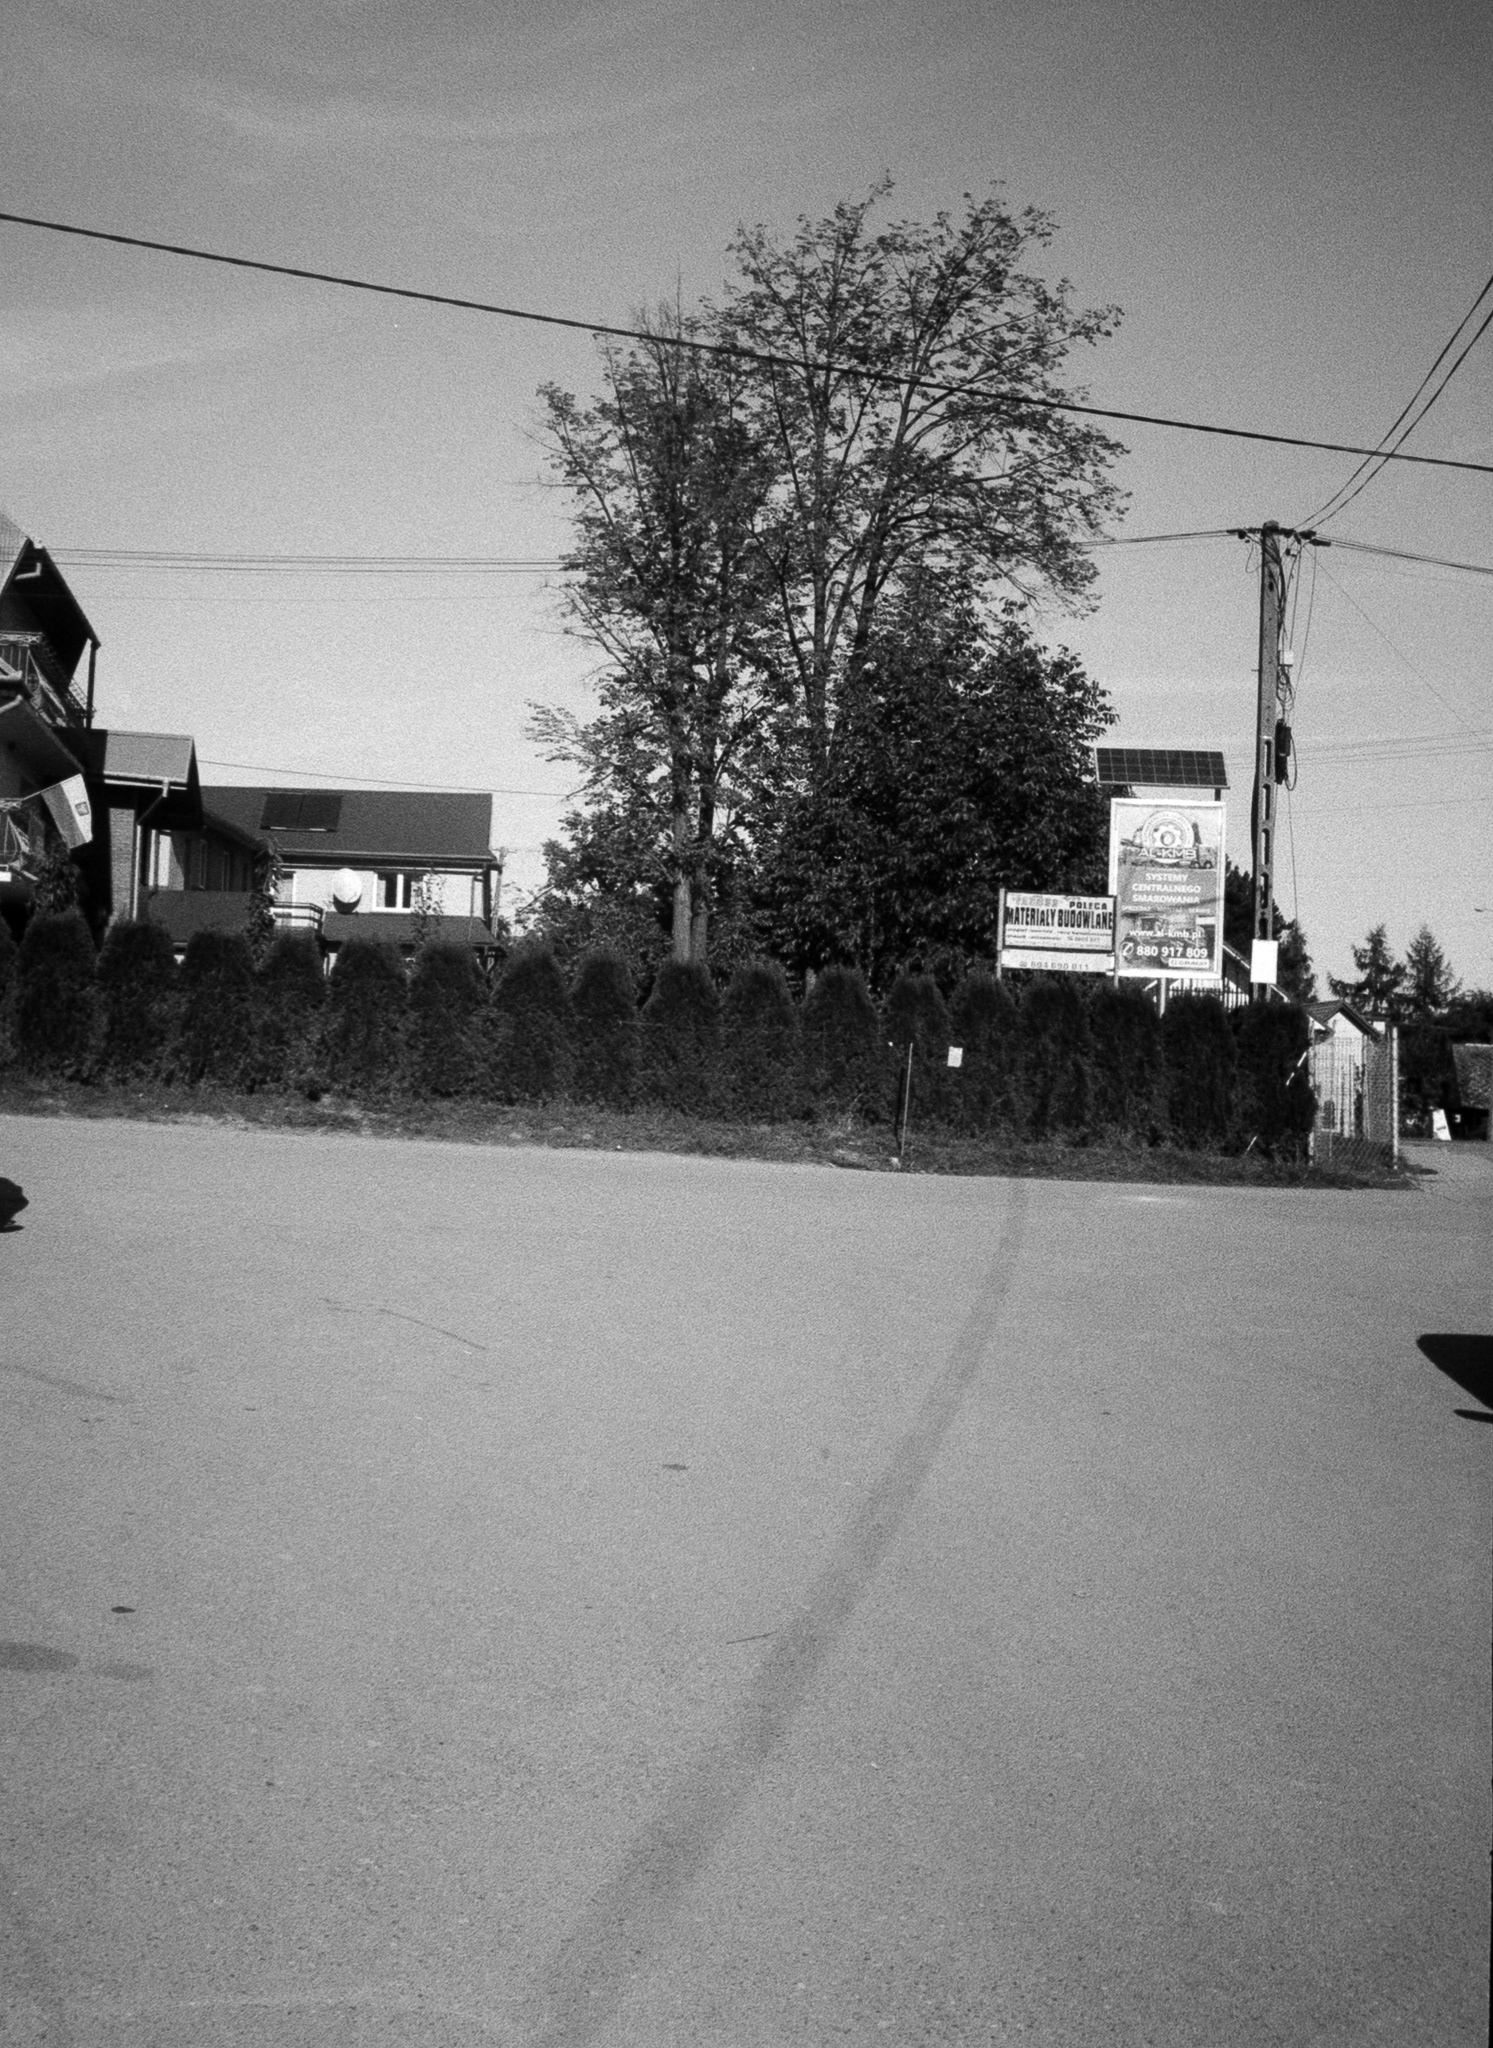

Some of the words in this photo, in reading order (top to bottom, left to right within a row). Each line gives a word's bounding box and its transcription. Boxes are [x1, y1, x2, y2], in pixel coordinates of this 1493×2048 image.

[1139, 848, 1197, 859] AL-KMB
[1145, 873, 1189, 882] SYSTEMY
[1132, 883, 1201, 894] CENTRALNEGO
[1132, 894, 1200, 904] SMAROWANIA
[1069, 901, 1107, 910] POLECA
[1058, 909, 1113, 930] BUDOWLANE
[1129, 928, 1202, 941] www.al-kmb.pl
[1136, 945, 1158, 956] 880
[1161, 946, 1183, 957] 917
[1186, 947, 1208, 958] 809
